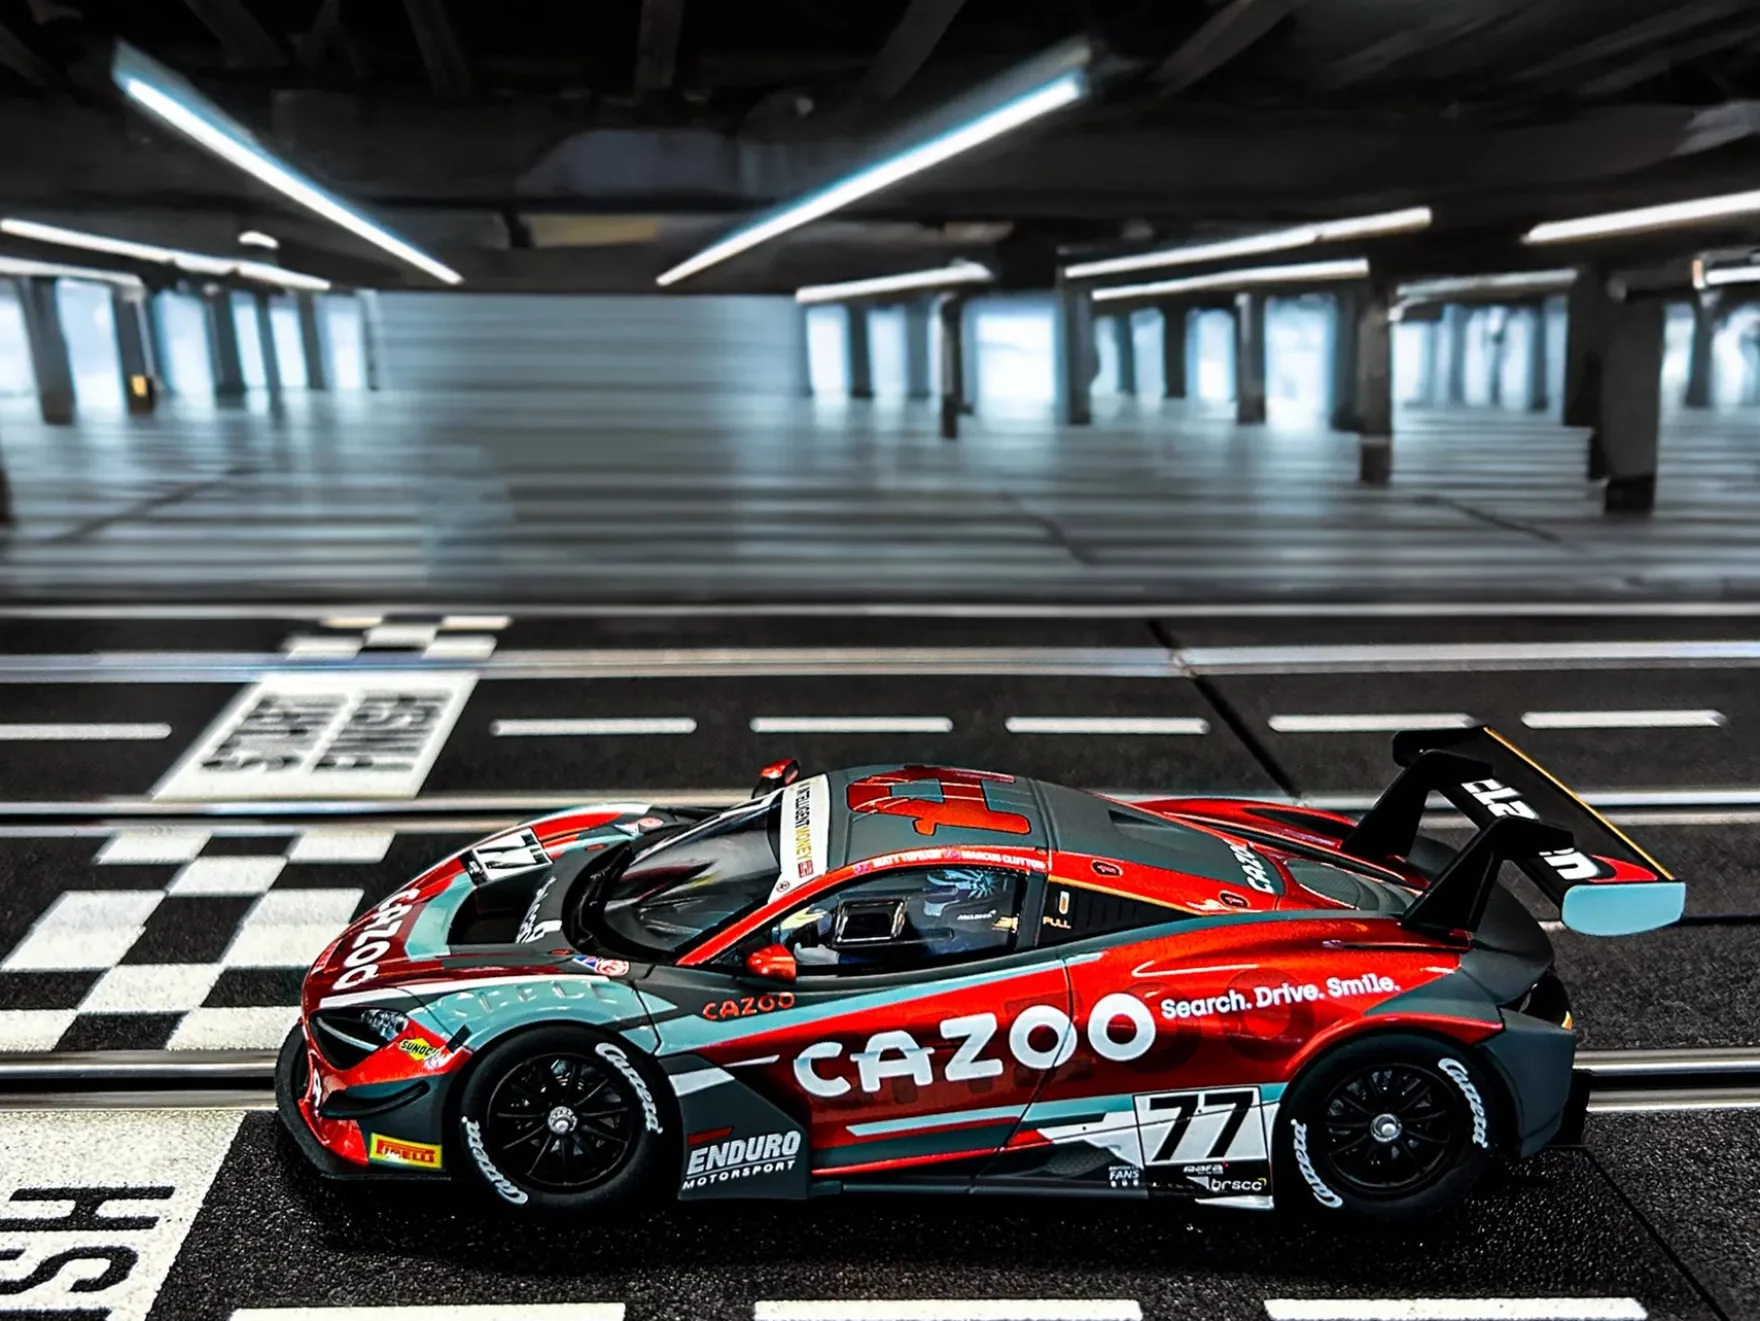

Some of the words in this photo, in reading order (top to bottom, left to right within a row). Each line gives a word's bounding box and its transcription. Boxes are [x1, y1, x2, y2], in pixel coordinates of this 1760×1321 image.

[1042, 916, 1072, 930] PULL
[702, 991, 796, 1021] CAZOO
[1161, 988, 1252, 1020] Search.
[1254, 982, 1325, 1009] Drive.
[1326, 973, 1401, 998] Smile.
[793, 993, 1156, 1097] CAZOO
[1149, 1090, 1255, 1162] 77
[686, 1130, 801, 1175] ENDURO
[682, 1160, 796, 1191] MOTORSPORT
[1210, 1178, 1263, 1192] brscc
